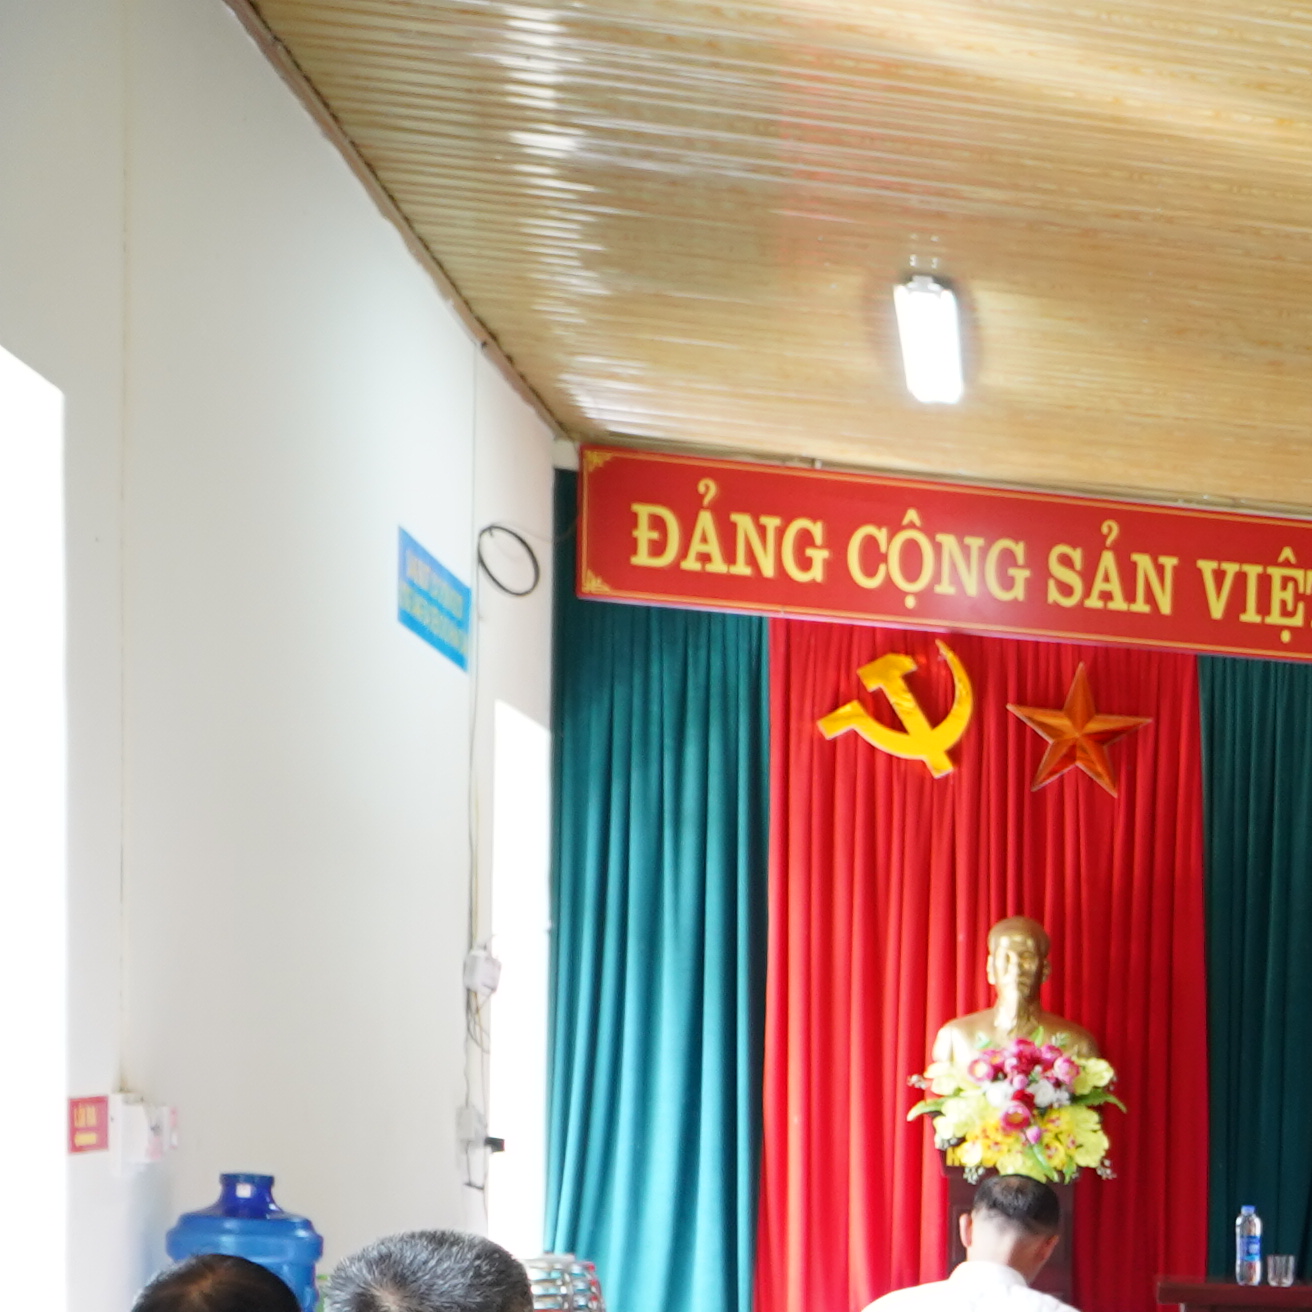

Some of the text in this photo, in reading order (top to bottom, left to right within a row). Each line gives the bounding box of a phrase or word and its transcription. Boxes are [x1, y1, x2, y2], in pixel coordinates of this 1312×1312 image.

[630, 478, 830, 582] ĐẢNG
[847, 509, 1031, 608] CỘNG
[1047, 520, 1178, 615] SẢN
